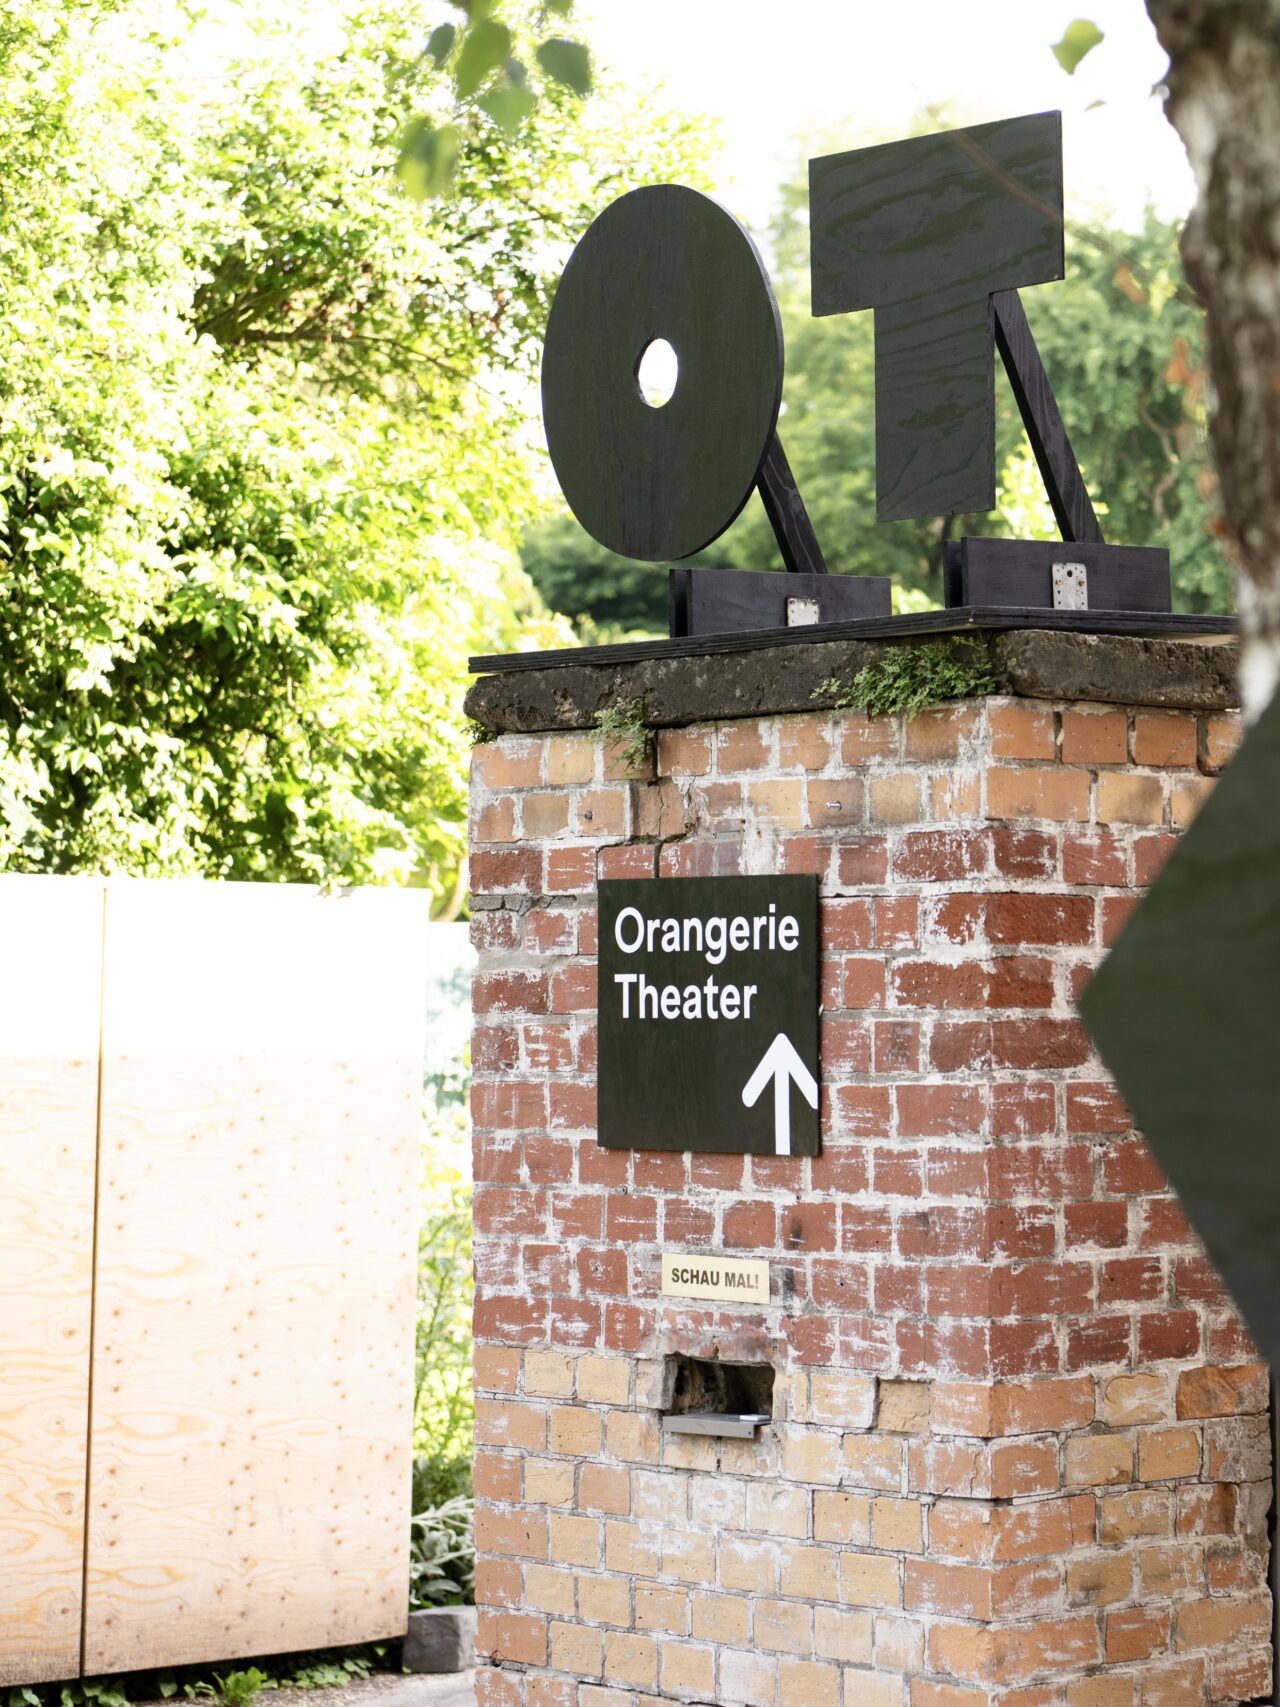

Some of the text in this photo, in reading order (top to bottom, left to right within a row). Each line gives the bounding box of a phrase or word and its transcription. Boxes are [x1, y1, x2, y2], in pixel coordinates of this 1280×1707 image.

[614, 903, 800, 965] Orangerie
[614, 973, 758, 1020] Theater
[671, 1267, 759, 1290] SCHAU MAL!
